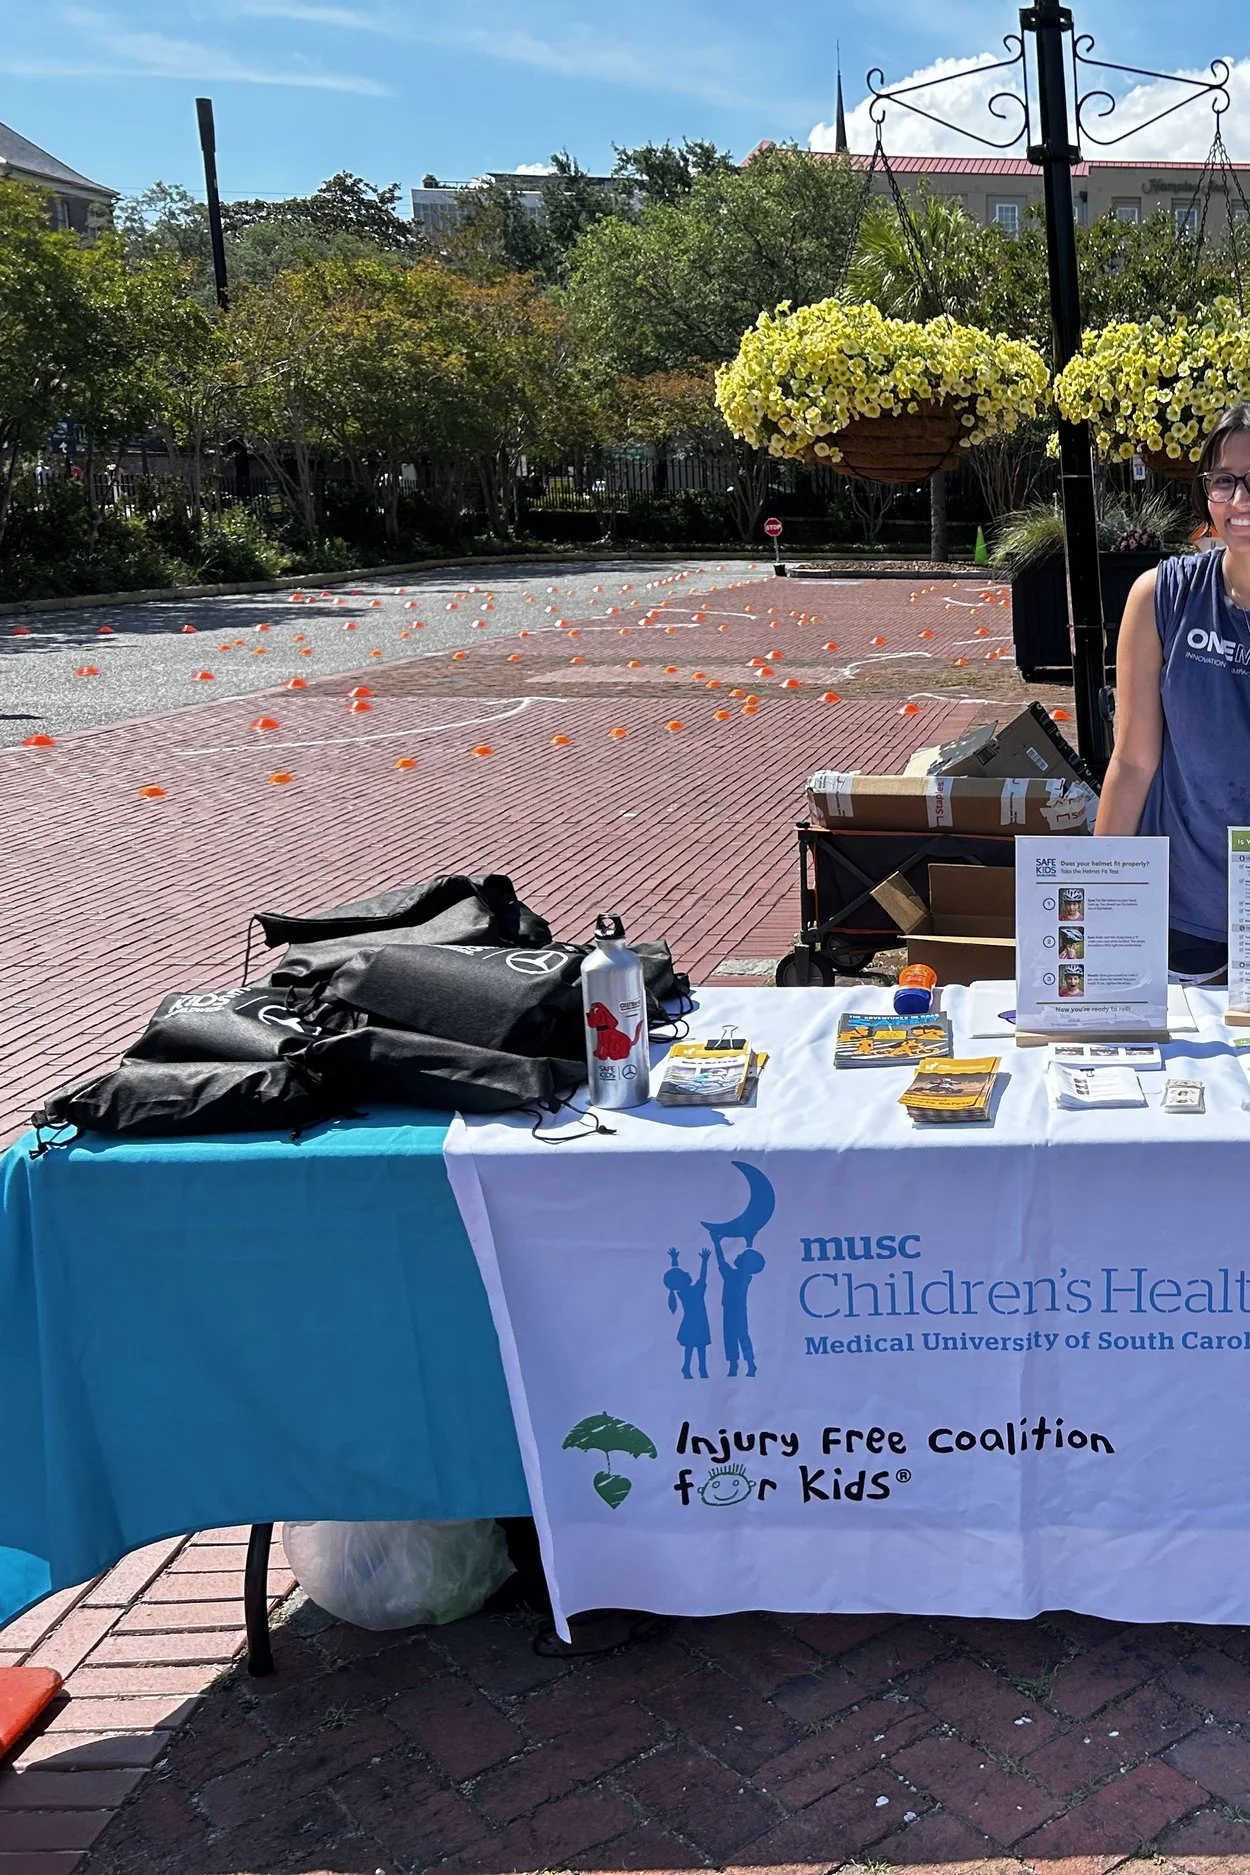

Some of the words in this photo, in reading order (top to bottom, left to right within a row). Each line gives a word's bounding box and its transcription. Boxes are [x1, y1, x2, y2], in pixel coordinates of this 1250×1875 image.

[1185, 651, 1226, 668] INNOVATION
[1036, 858, 1056, 866] SAFE
[801, 1233, 921, 1262] musc
[800, 1267, 1093, 1319] Children's
[805, 1332, 914, 1355] Medical
[922, 1331, 1059, 1352] University
[1065, 1331, 1091, 1350] of
[1098, 1332, 1175, 1350] South
[676, 1421, 799, 1464] Injury
[822, 1427, 906, 1455] Free
